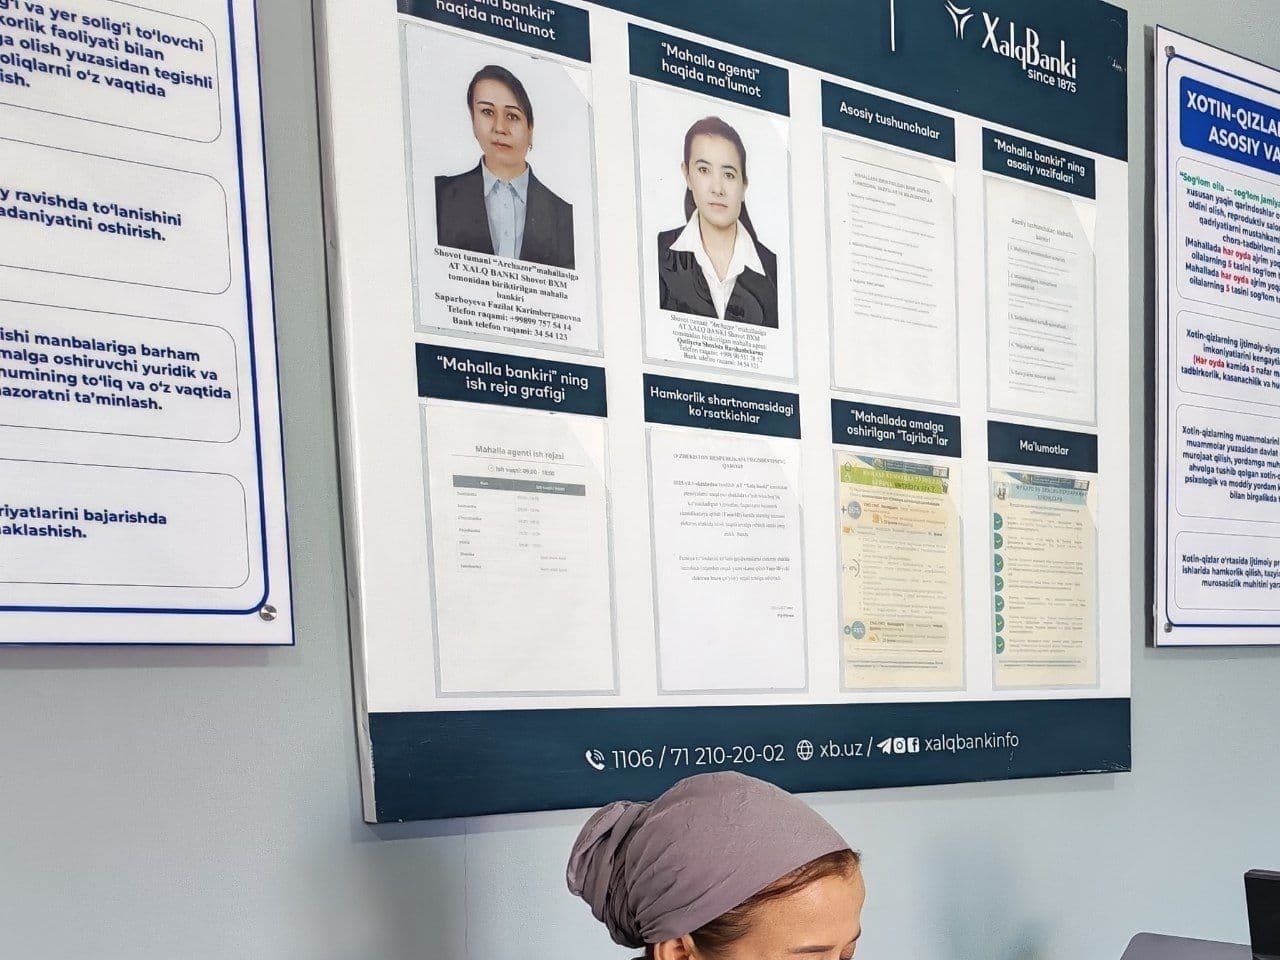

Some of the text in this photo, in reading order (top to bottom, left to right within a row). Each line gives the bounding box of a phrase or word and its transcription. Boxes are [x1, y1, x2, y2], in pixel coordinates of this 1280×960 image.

[436, 0, 487, 22] haqida
[25, 2, 44, 15] va
[50, 7, 76, 22] yer
[82, 14, 131, 34] solig‘i
[136, 24, 204, 50] to‘lovchi
[51, 23, 120, 51] faoliyati
[124, 40, 164, 61] bilan
[20, 37, 60, 55] olish
[66, 48, 150, 75] yuzasidan
[154, 65, 213, 88] tegishli
[662, 58, 703, 81] haqida
[76, 67, 100, 83] o‘z
[105, 75, 166, 97] vaqtida
[1027, 68, 1076, 93] since 1875
[840, 101, 940, 140] Asosiy tushunchalar
[1209, 127, 1260, 156] ASOSIY
[1007, 158, 1074, 184] asosiy vazifalari
[16, 191, 88, 211] ravishda
[93, 201, 182, 226] to‘lanishini
[98, 221, 166, 240] oshirish.
[34, 334, 136, 356] manbalariga
[141, 343, 200, 361] barham
[54, 353, 138, 372] oshiruvchi
[142, 363, 196, 378] yuridik
[201, 369, 218, 380] va
[437, 357, 589, 389] “Mahalla bankiri” ning
[0, 386, 163, 409] azoratni ta’minlash.
[82, 373, 123, 391] to‘liq
[128, 379, 145, 390] va
[150, 379, 172, 392] o‘z
[176, 384, 232, 398] vaqtida
[466, 377, 565, 402] ish reja grafigi
[650, 385, 794, 415] Hamkorlik shartnomasidagi
[847, 424, 895, 441] oshirilgan
[84, 508, 167, 524] bajarishda
[0, 523, 87, 538] aklashish.
[612, 749, 654, 768] 1106
[671, 748, 689, 767] 71
[696, 744, 785, 765] 210-20-02
[821, 740, 863, 758] xb.uz
[925, 733, 1019, 753] xalqbankinfo
